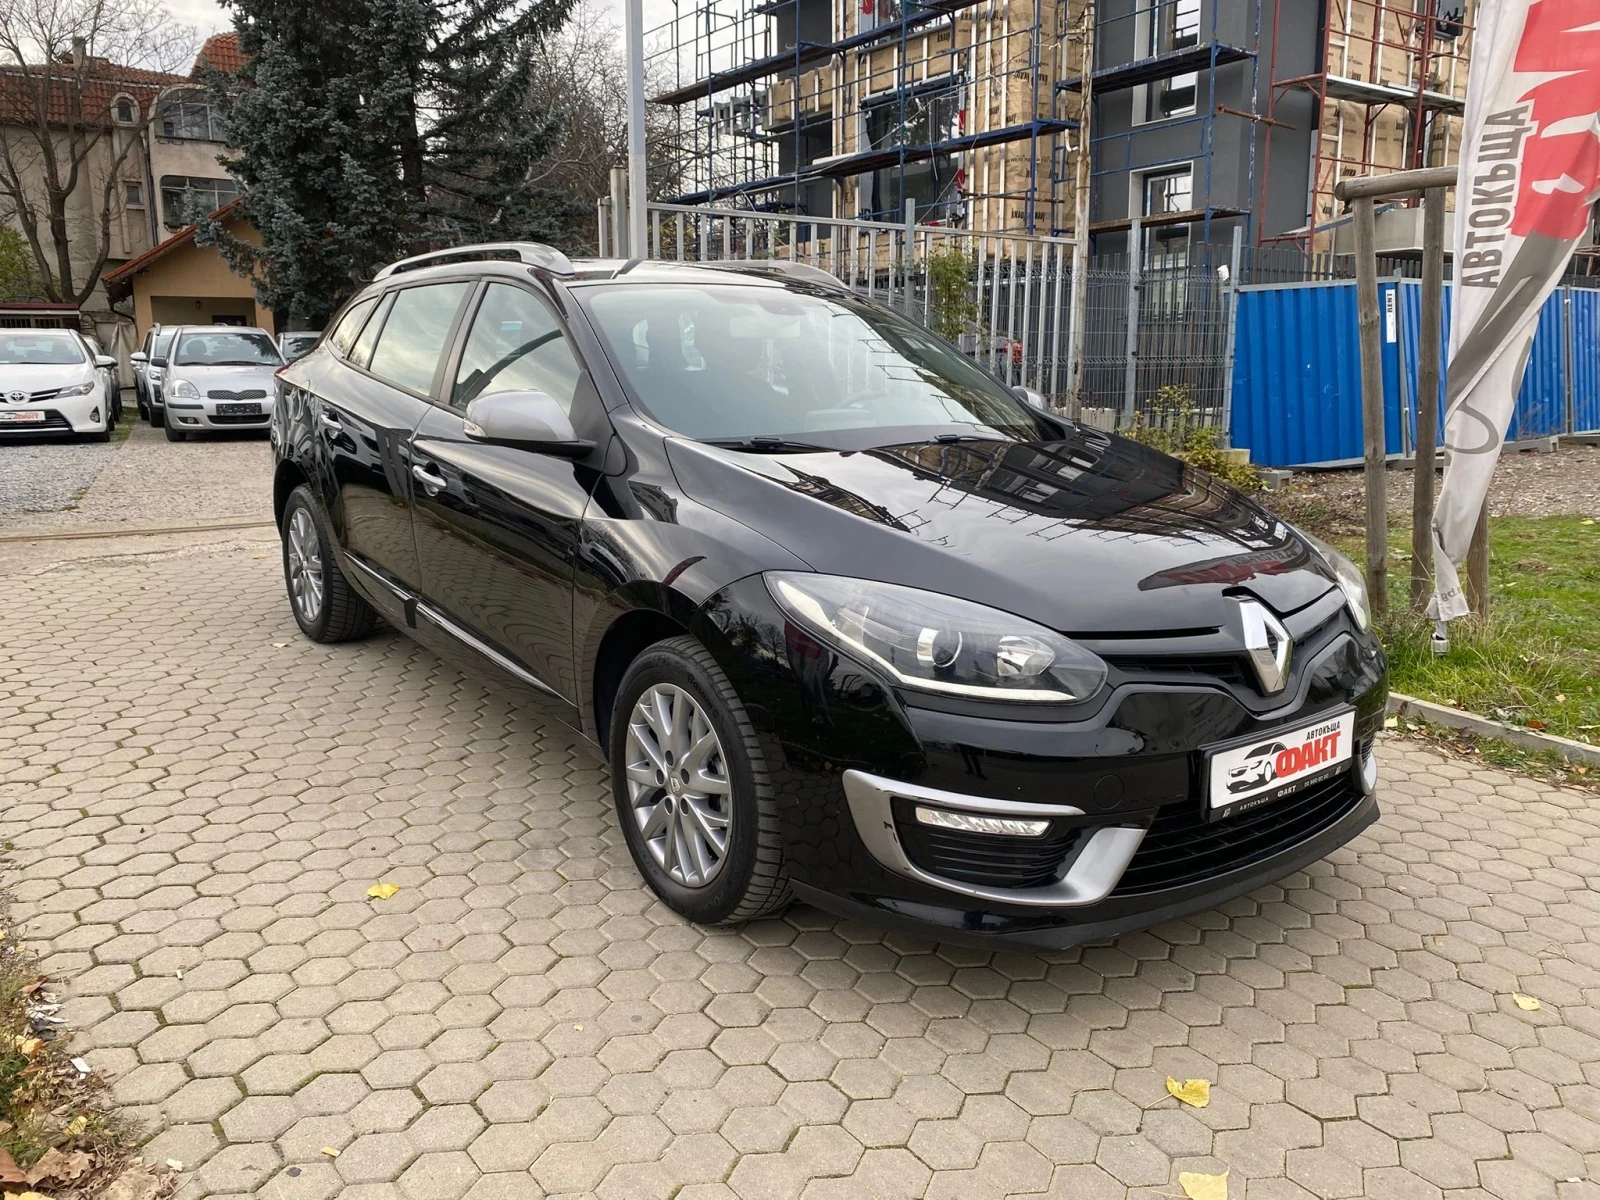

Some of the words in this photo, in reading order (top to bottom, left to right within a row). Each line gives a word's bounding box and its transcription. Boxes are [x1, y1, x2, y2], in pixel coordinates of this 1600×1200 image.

[1461, 105, 1532, 288] АВТОКЪЩА
[687, 672, 713, 710] Barum
[1306, 721, 1340, 741] АВТОКЪЩА
[1276, 731, 1341, 778] ФАКТ
[1277, 785, 1297, 797] ФАКТ
